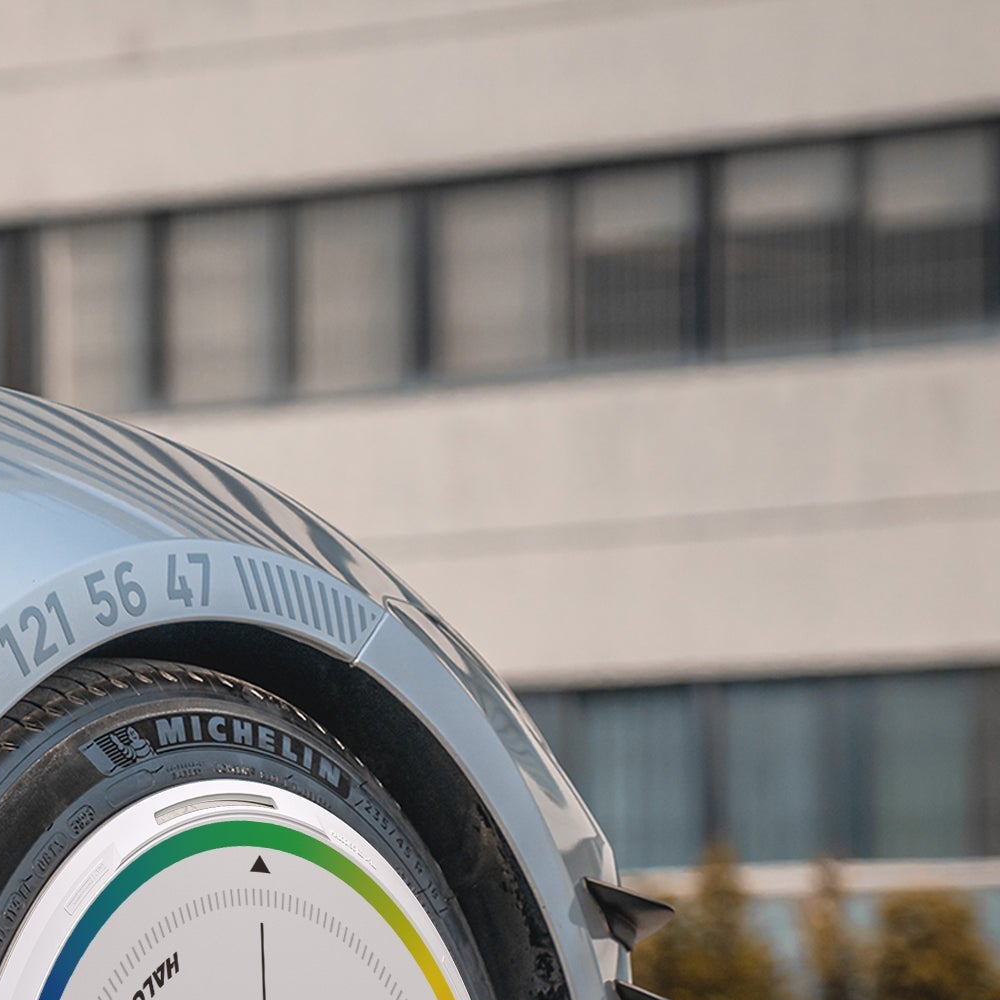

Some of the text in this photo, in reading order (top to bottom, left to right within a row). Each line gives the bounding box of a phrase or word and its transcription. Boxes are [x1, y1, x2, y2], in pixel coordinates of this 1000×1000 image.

[84, 561, 147, 627] 56
[167, 553, 211, 607] 47
[154, 715, 342, 788] MICHELIN
